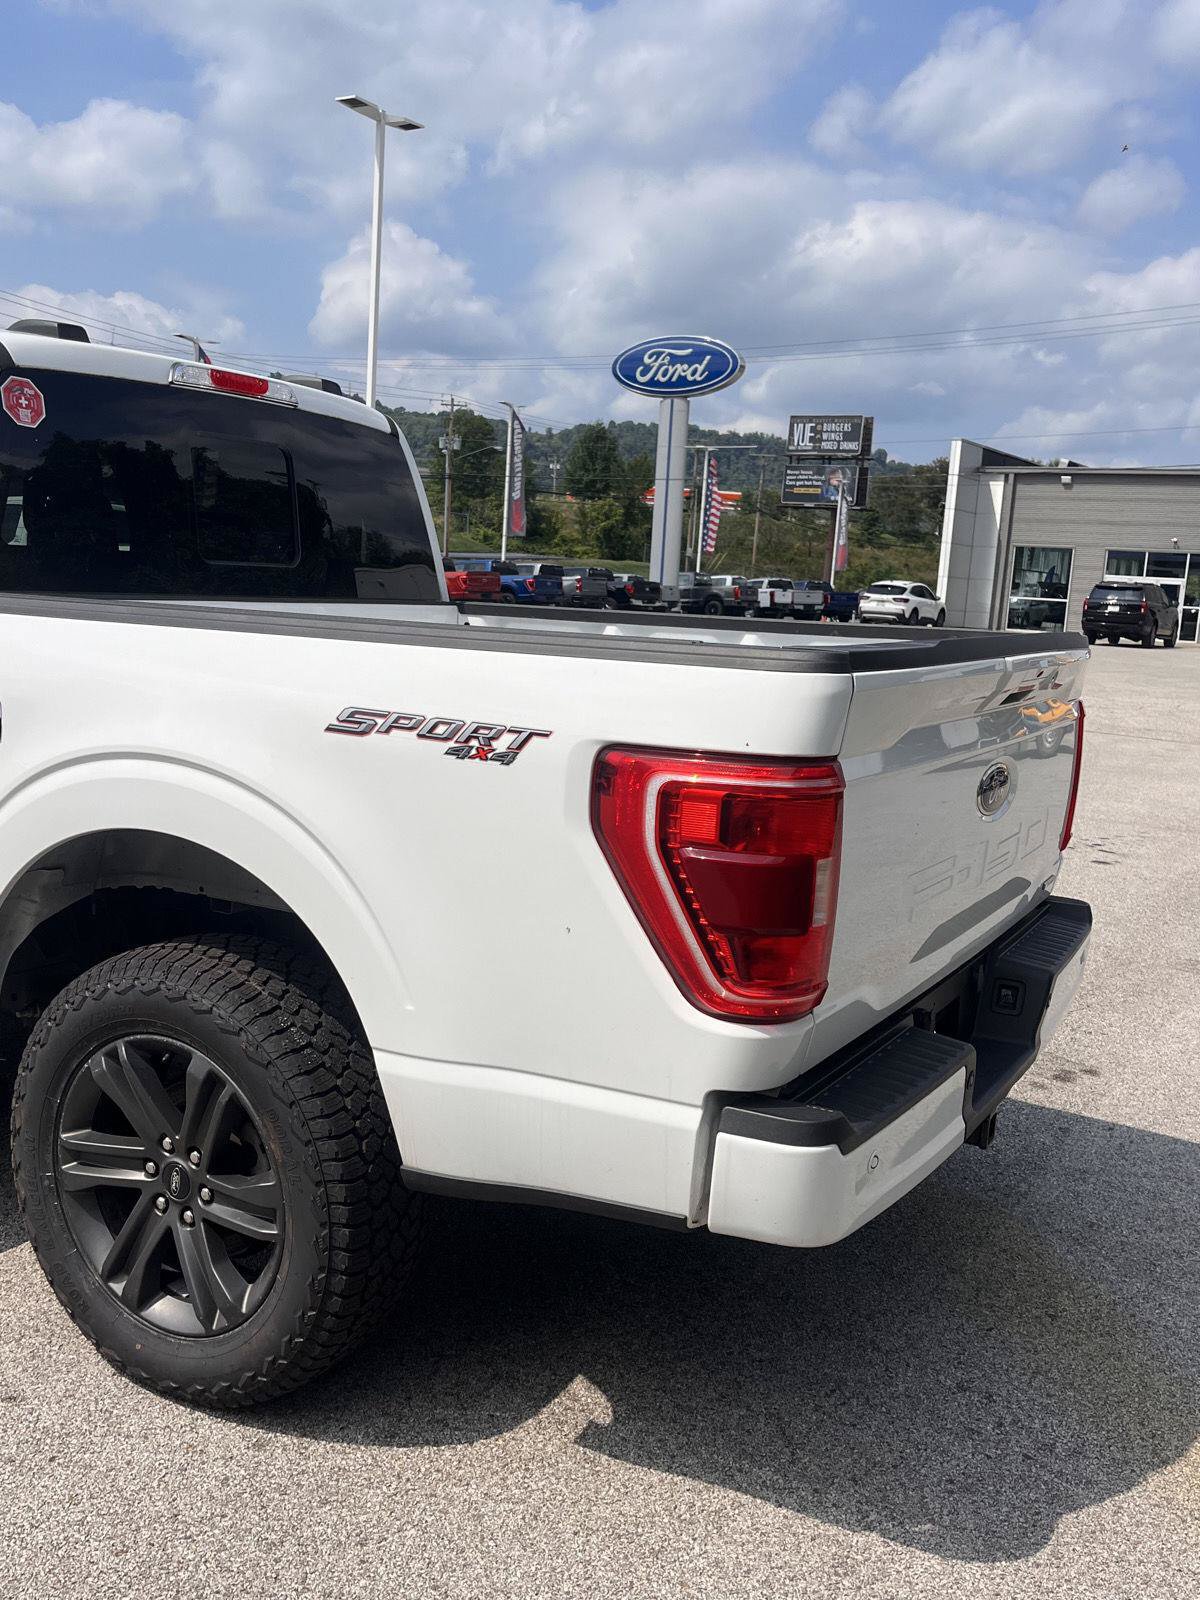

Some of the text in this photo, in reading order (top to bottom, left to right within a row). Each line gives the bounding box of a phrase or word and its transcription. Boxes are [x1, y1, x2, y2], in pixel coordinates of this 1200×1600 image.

[635, 348, 711, 383] Ford
[794, 423, 815, 446] VUE
[823, 423, 851, 431] BURGERS
[822, 432, 843, 441] WINGS
[821, 441, 838, 450] MIXED
[840, 442, 859, 450] DRINKS
[324, 706, 552, 752] SPORT
